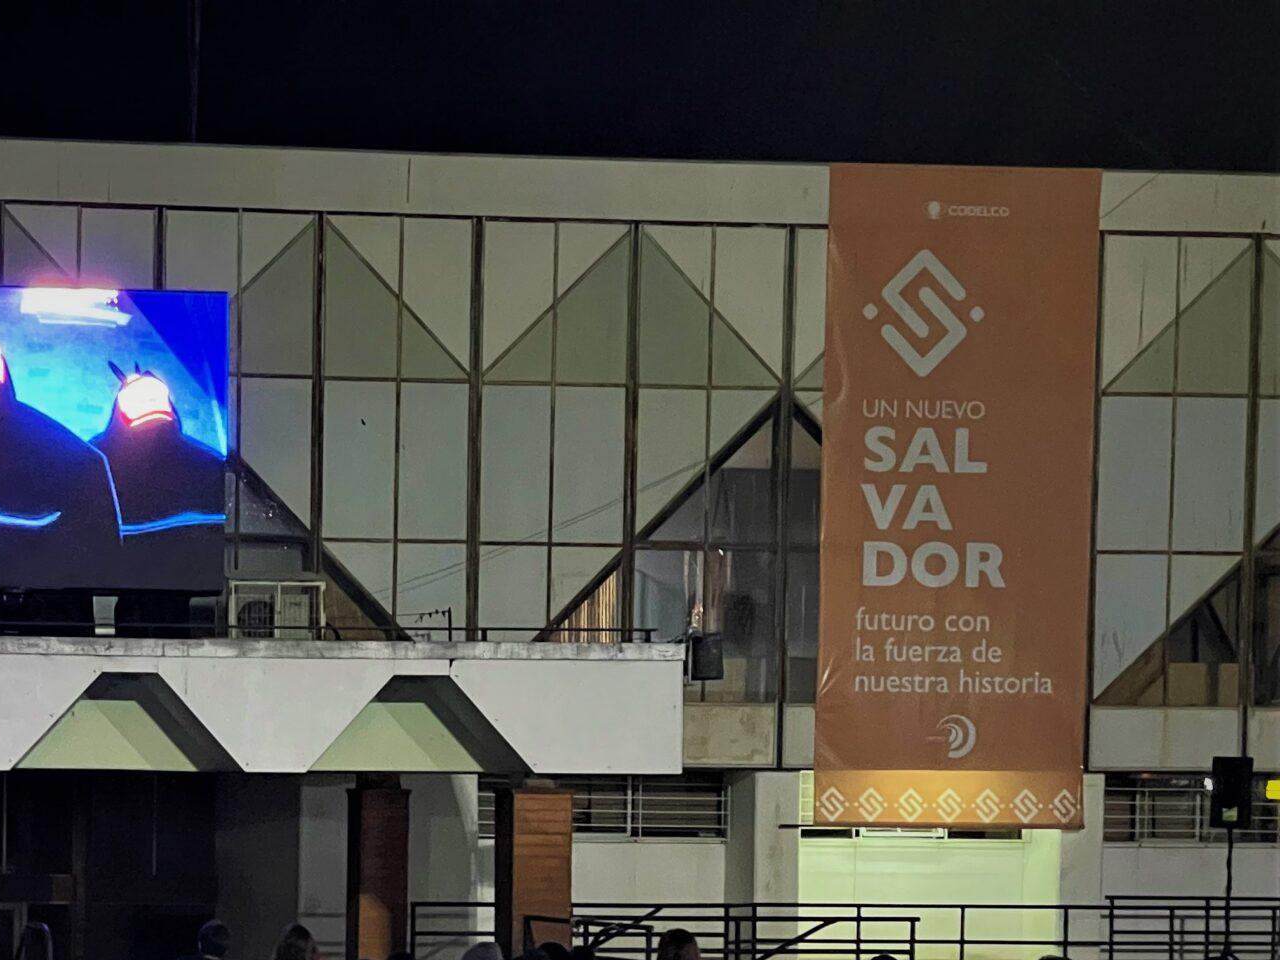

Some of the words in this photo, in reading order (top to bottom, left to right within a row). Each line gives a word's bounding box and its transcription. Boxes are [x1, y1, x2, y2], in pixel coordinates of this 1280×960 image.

[948, 205, 1010, 217] CODELCO
[862, 398, 897, 419] UN
[905, 400, 986, 420] NUEVO
[863, 425, 988, 474] SAL
[860, 483, 953, 531] VA
[862, 540, 1007, 588] DOR
[855, 606, 935, 632] futuro
[944, 614, 991, 633] con
[855, 637, 875, 662] la
[884, 637, 963, 663] fuerza
[972, 638, 1003, 663] de
[854, 673, 949, 694] nuestra
[959, 668, 1054, 695] historia
